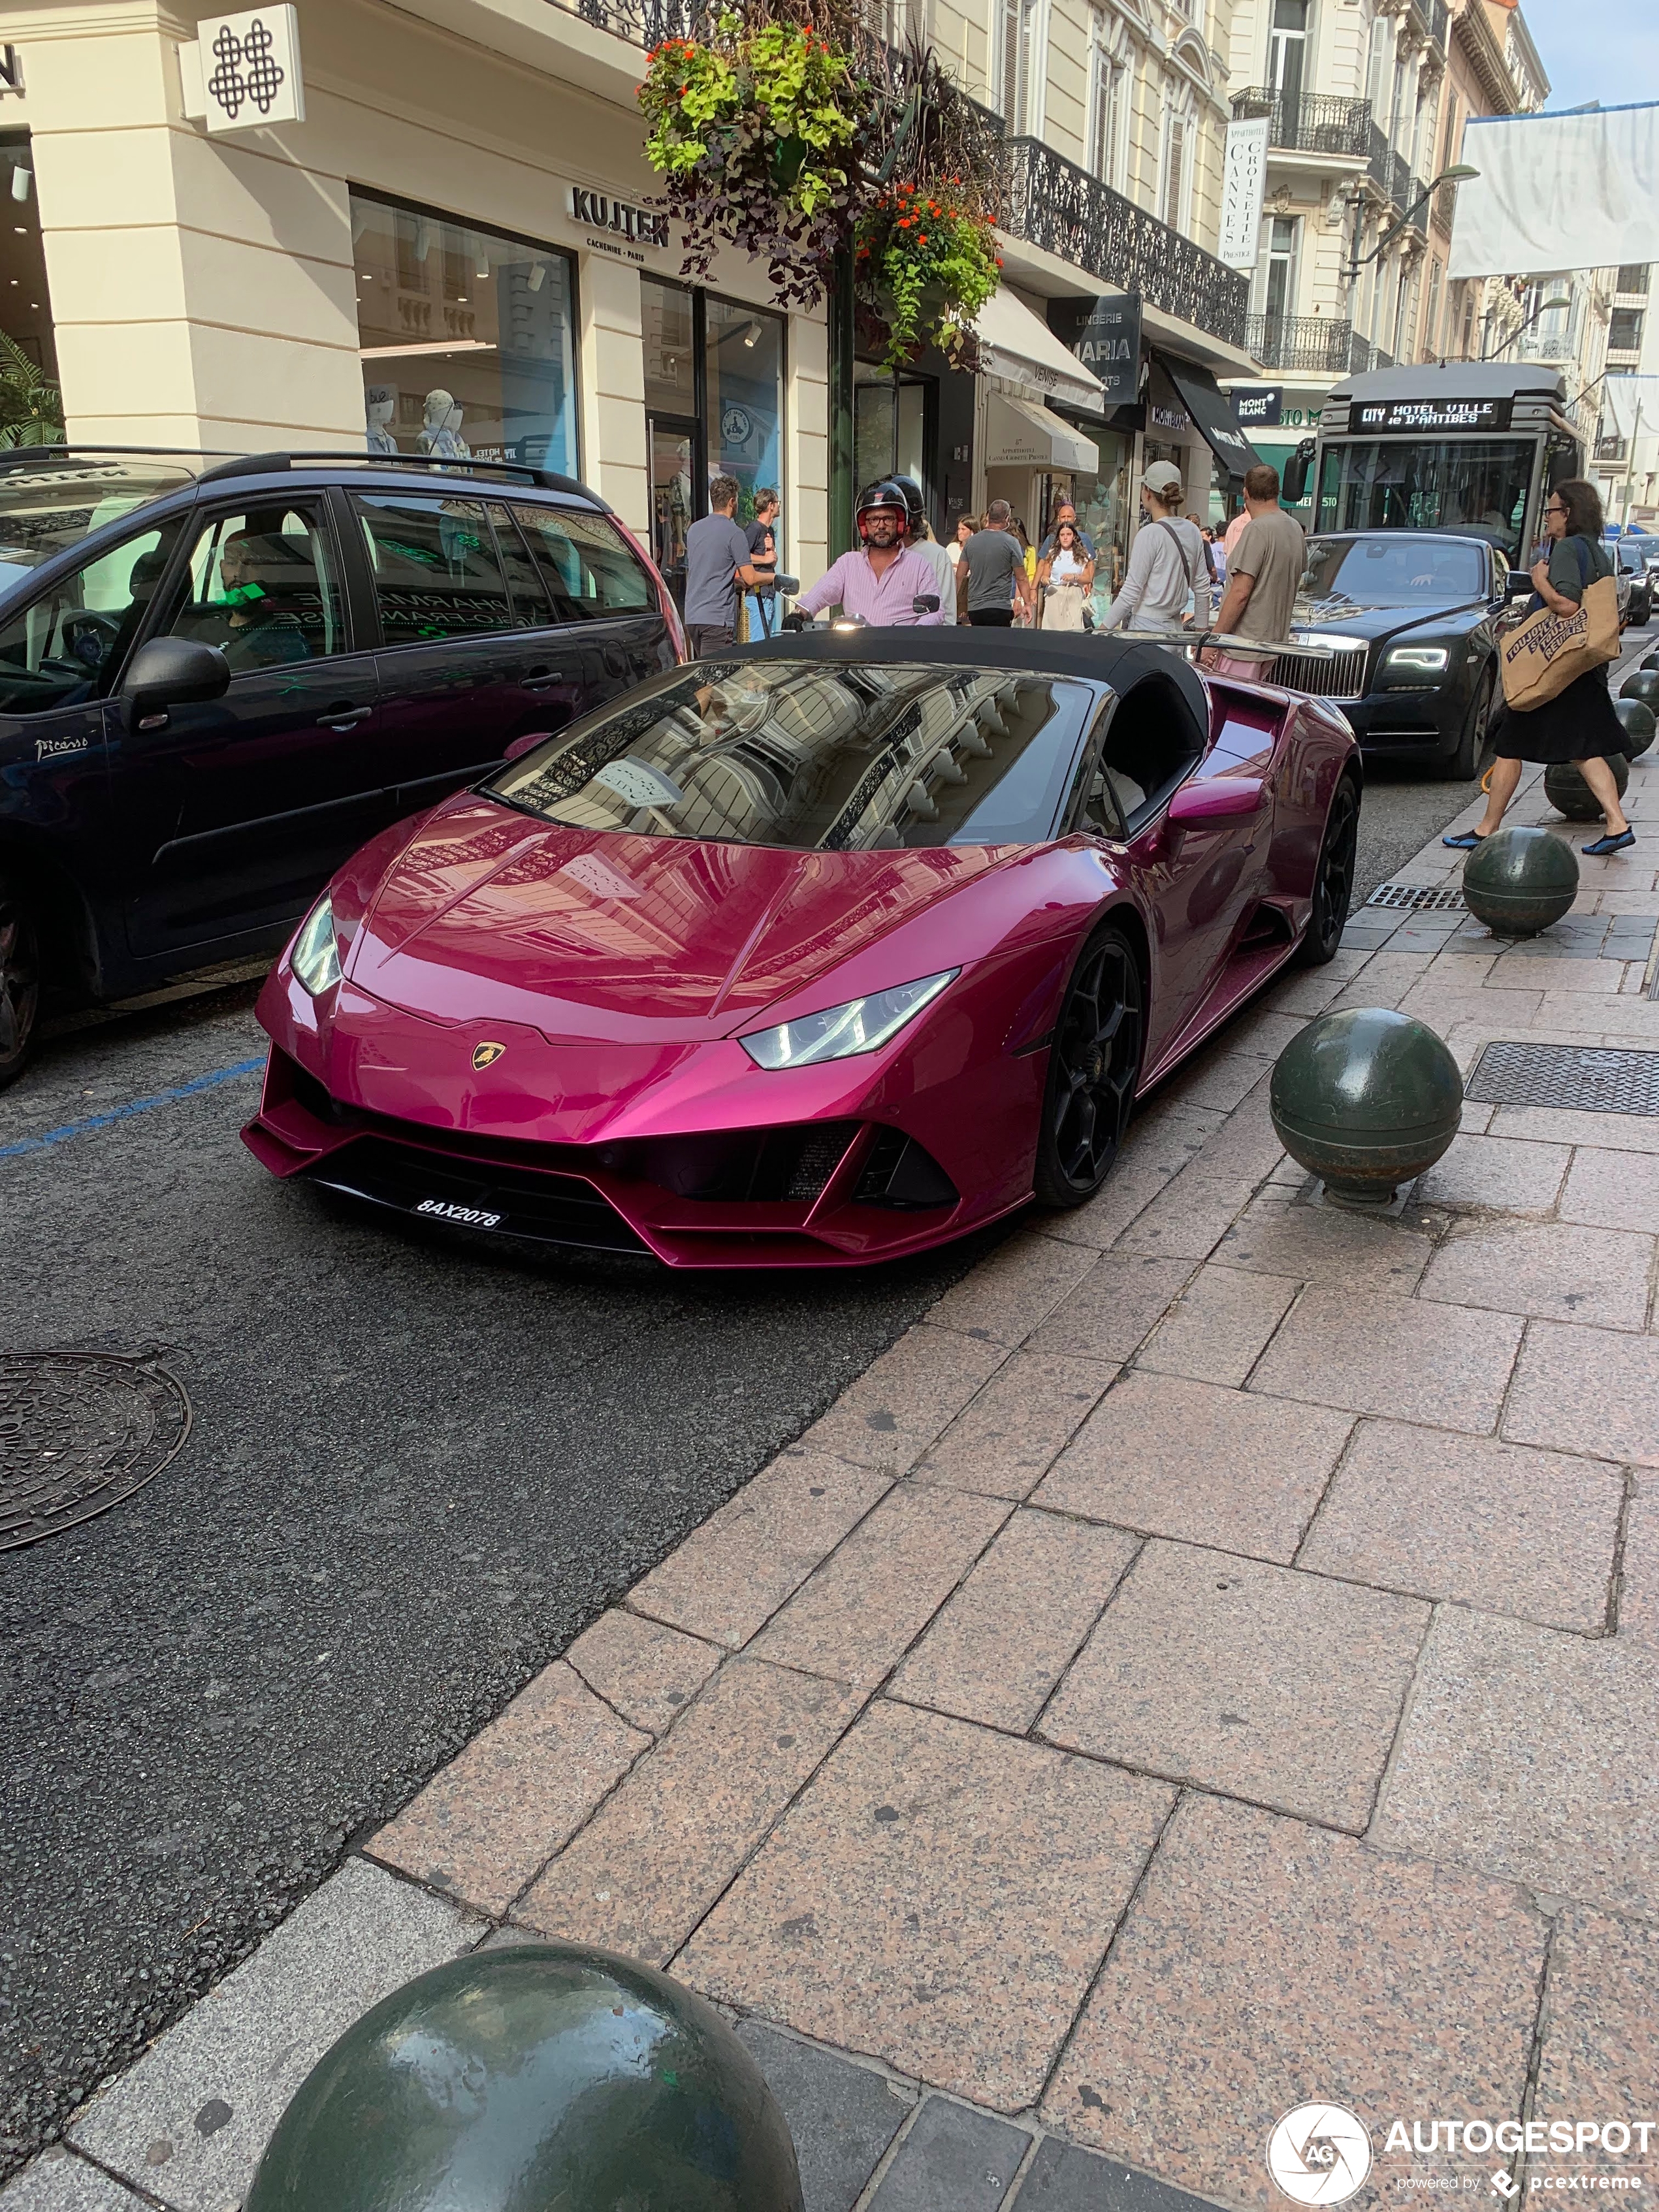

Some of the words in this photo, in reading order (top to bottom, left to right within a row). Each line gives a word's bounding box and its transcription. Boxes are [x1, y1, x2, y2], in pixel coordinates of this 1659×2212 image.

[1231, 127, 1264, 138] APPARTHOTEL
[1225, 143, 1244, 244] CANNES
[1242, 141, 1261, 243] CROISETTE
[573, 187, 668, 248] KUJTEN
[587, 238, 622, 255] CACHEMIRE
[628, 251, 645, 262] PARIS
[1223, 250, 1251, 259] PRESTIGE
[1076, 312, 1122, 326] LINGERIE
[1035, 366, 1059, 387] VENISE
[1238, 407, 1266, 416] BLANC
[1239, 398, 1266, 408] MONT
[1393, 404, 1438, 415] HOTEL
[1447, 403, 1493, 414] VILLE
[1405, 413, 1478, 425] D'ANTIBES
[1541, 610, 1587, 650] TOUJOURS
[417, 1200, 501, 1226] 8AX2078
